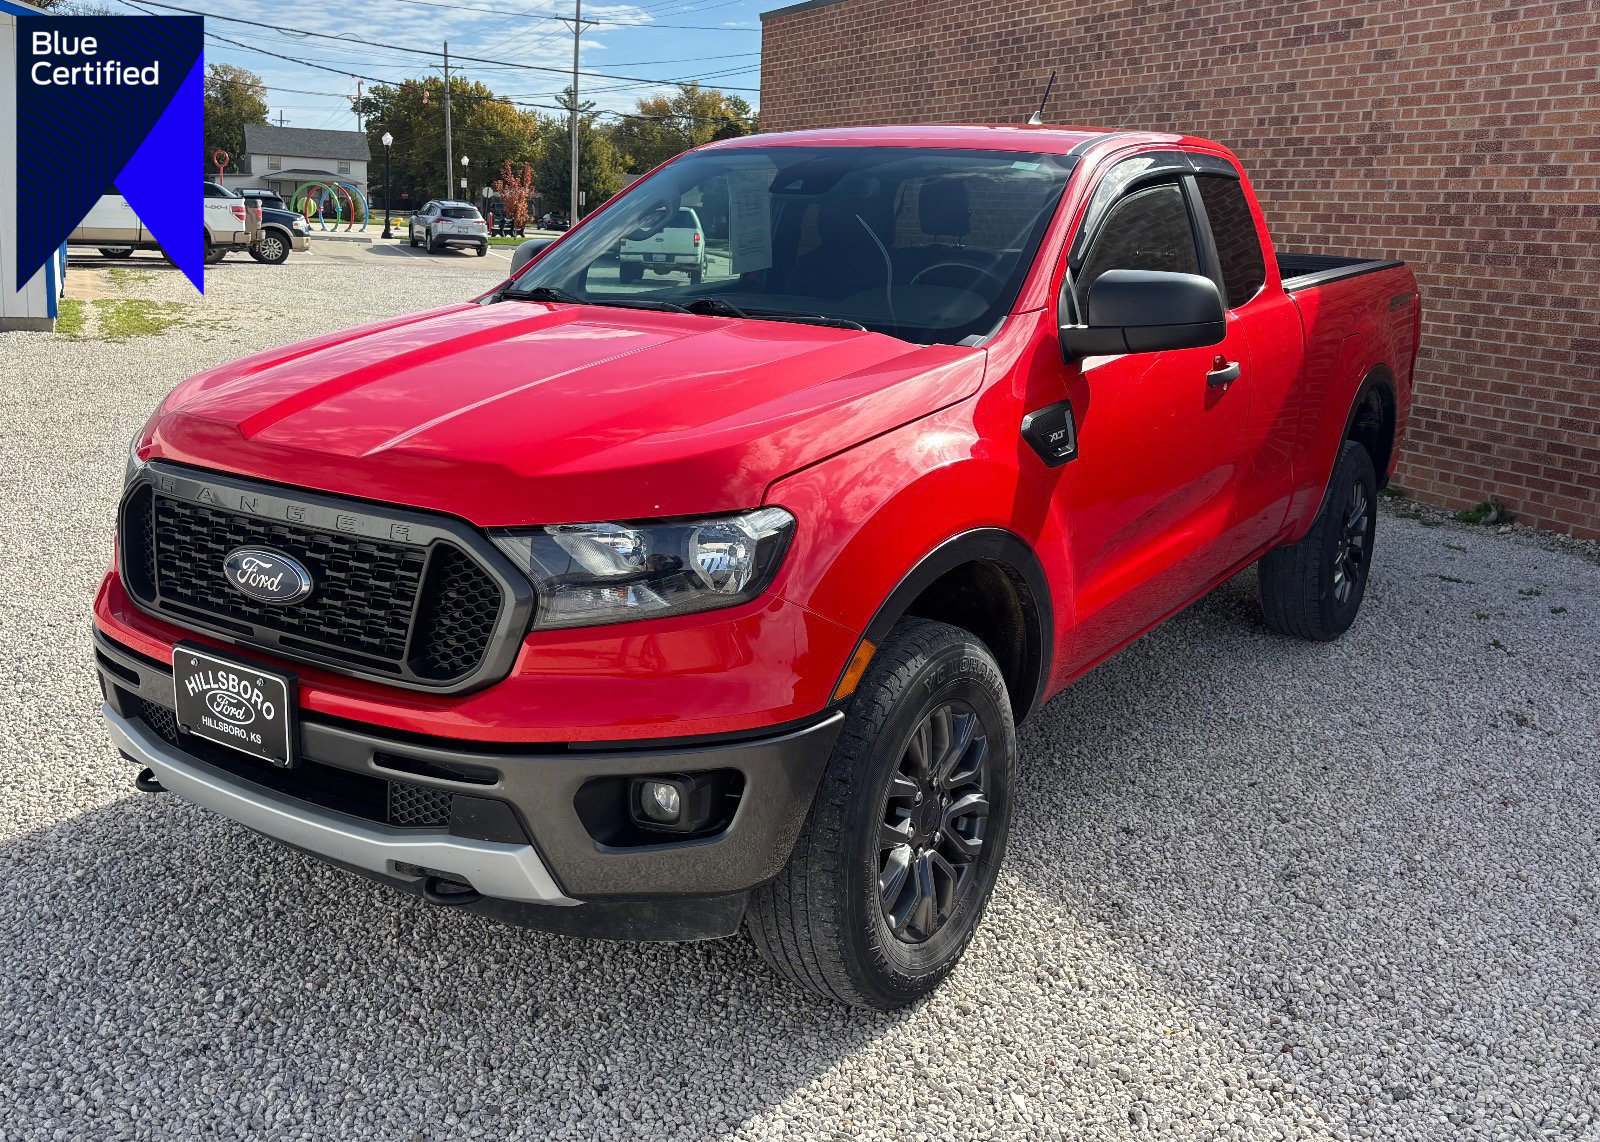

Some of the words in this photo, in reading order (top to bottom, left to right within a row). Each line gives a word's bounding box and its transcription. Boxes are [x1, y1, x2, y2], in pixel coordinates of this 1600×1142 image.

[1048, 428, 1066, 443] XLT
[160, 476, 412, 542] RANGER
[236, 557, 284, 593] Ford
[184, 670, 275, 721] HILLSBORO
[213, 693, 246, 721] Ford
[202, 715, 249, 742] HILLSBORO,
[250, 731, 262, 745] KS
